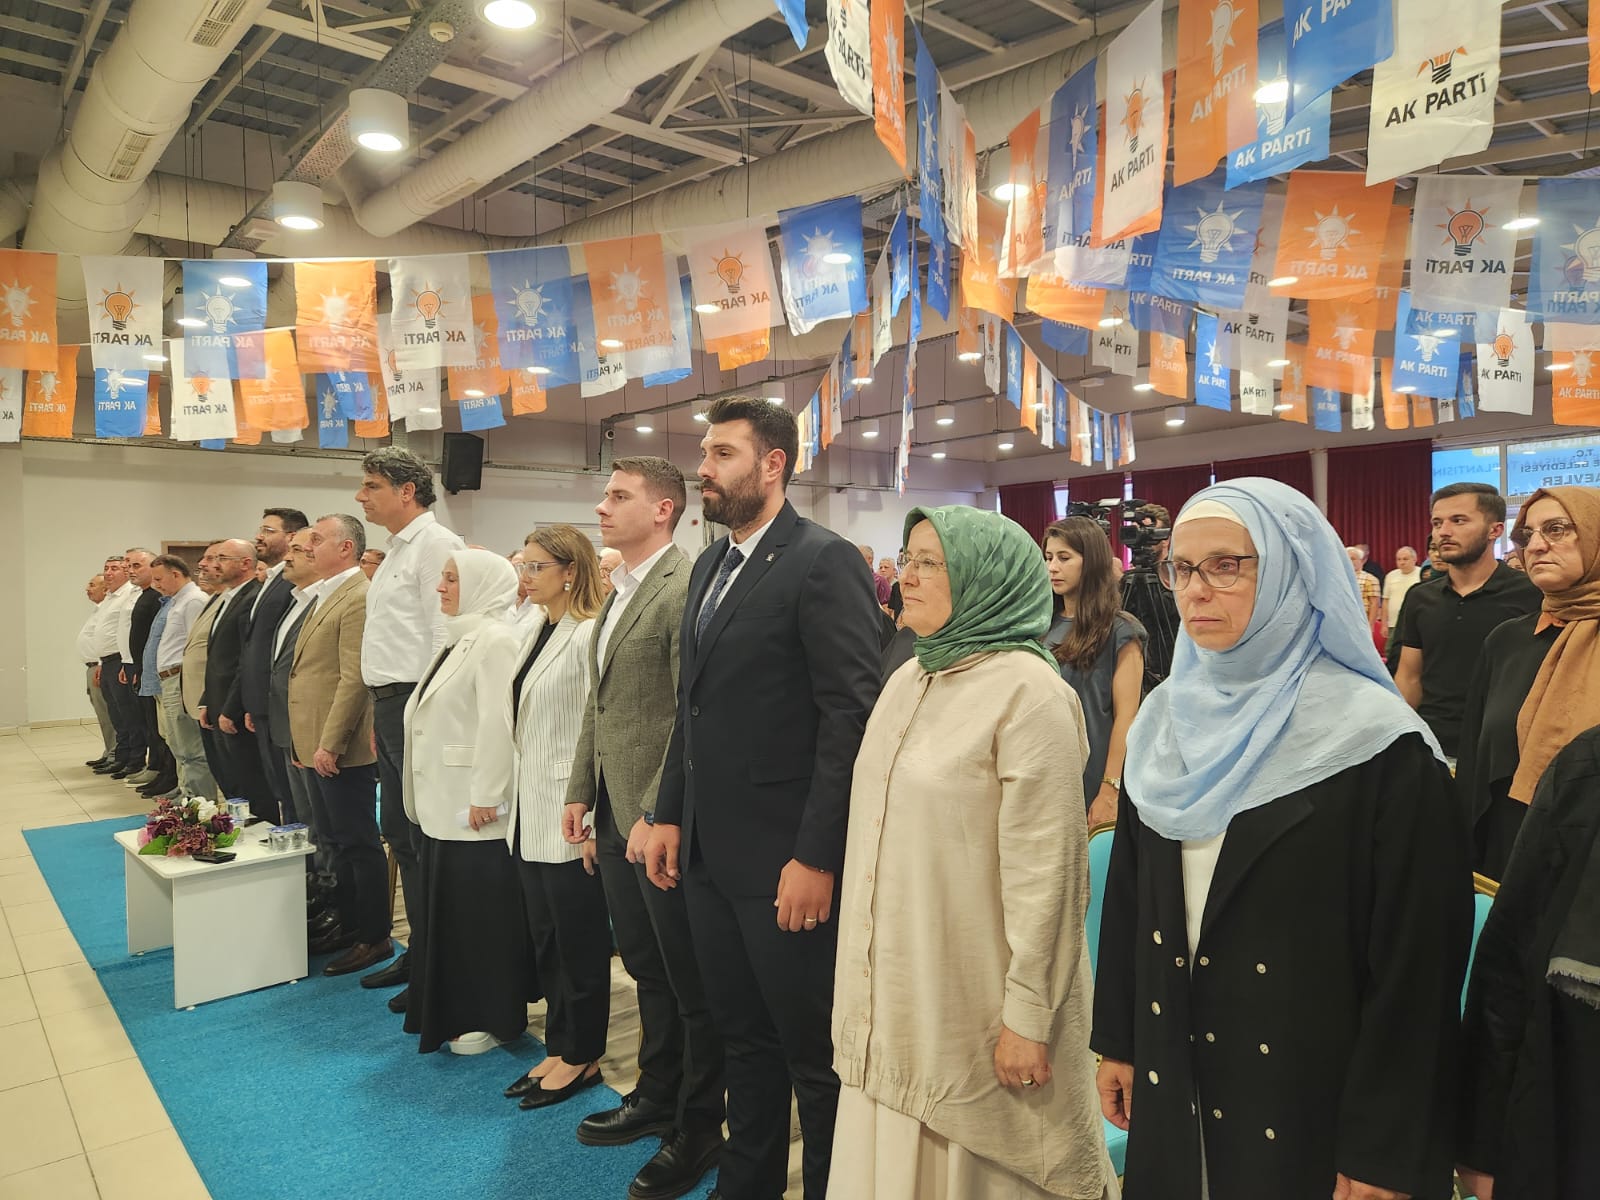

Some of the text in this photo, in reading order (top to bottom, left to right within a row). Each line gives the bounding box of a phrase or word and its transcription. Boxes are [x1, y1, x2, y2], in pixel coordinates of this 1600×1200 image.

[1293, 0, 1351, 49] AK PA
[1213, 64, 1247, 100] ARTi
[1385, 99, 1418, 128] AK
[1235, 147, 1256, 169] AK
[1111, 168, 1126, 193] AK
[971, 270, 990, 284] AK
[1415, 312, 1433, 323] AK
[1224, 321, 1241, 334] AK
[1099, 336, 1132, 356] AK RTi
[1316, 347, 1332, 360] AK
[1400, 359, 1415, 372] AK
[1198, 375, 1210, 385] AK
[1481, 368, 1490, 380] AK
[1243, 384, 1255, 396] AK
[1558, 387, 1572, 399] AK
